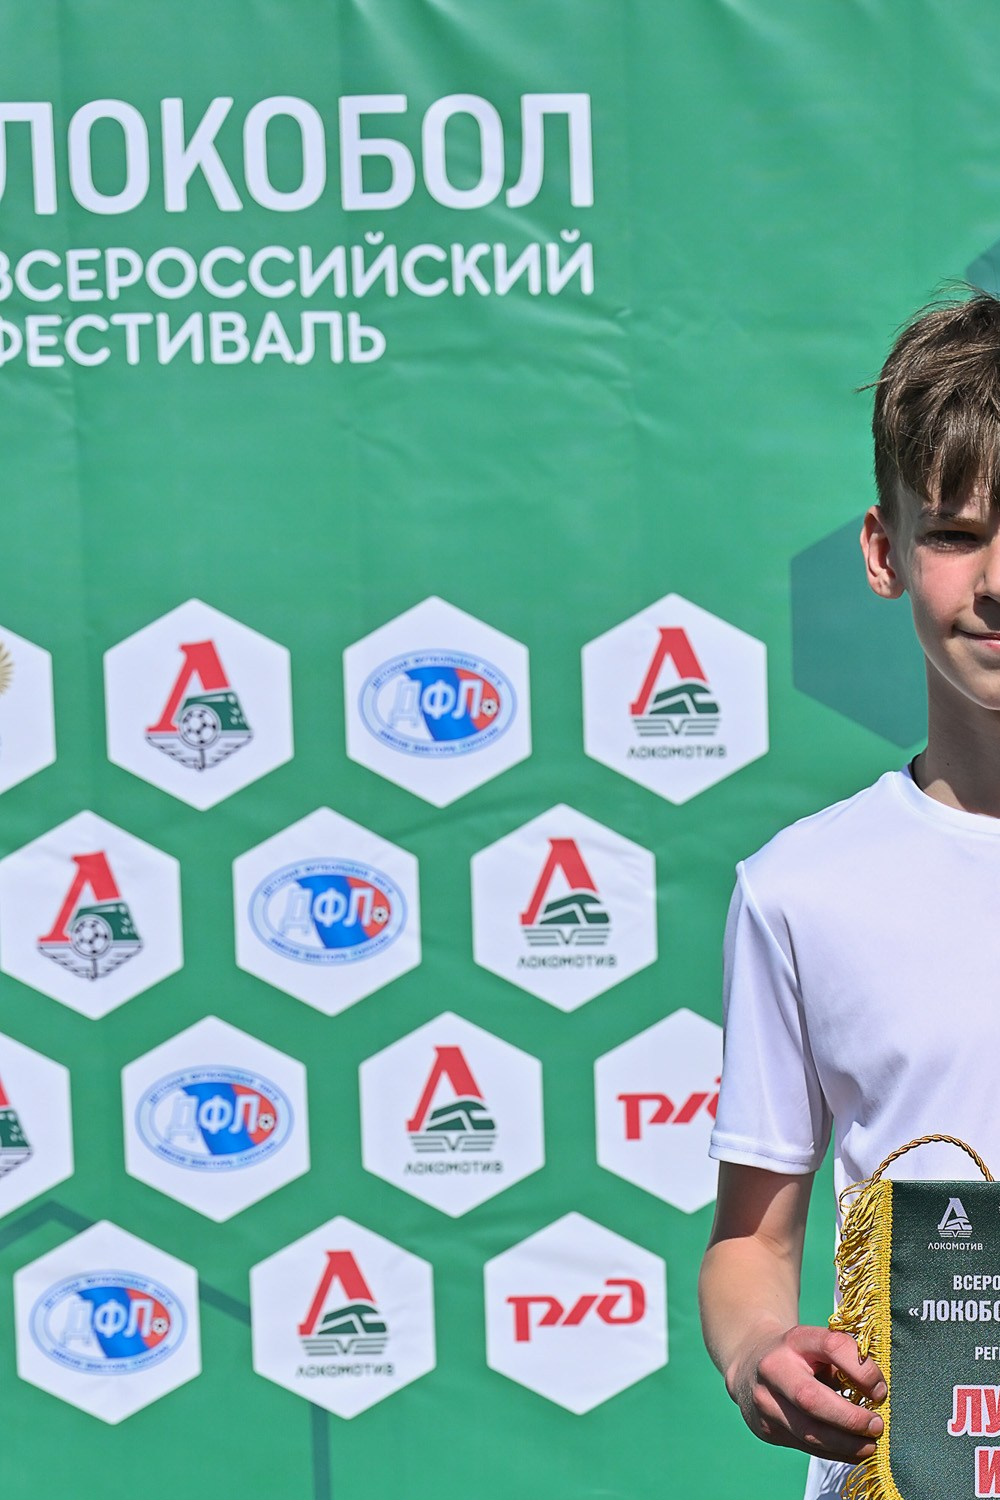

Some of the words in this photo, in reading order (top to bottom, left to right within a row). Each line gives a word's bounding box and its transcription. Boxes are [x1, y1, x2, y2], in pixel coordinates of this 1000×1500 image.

[0, 92, 594, 215] ЛОКОБОЛ
[388, 679, 483, 728] ДФЛ
[626, 744, 727, 760] ЛОКОМОТИВ
[279, 888, 375, 936] ДФЛ
[517, 953, 617, 969] ЛОКОМОТИВ
[167, 1095, 260, 1143] ДФЛ
[403, 1160, 504, 1175] ЛОКОМОТИВ
[927, 1242, 983, 1251] ЛОКОМОТИВ
[61, 1299, 154, 1346] ДФЛ
[507, 1278, 645, 1343] РЖД
[295, 1362, 396, 1378] ЛОКОМОТИВ
